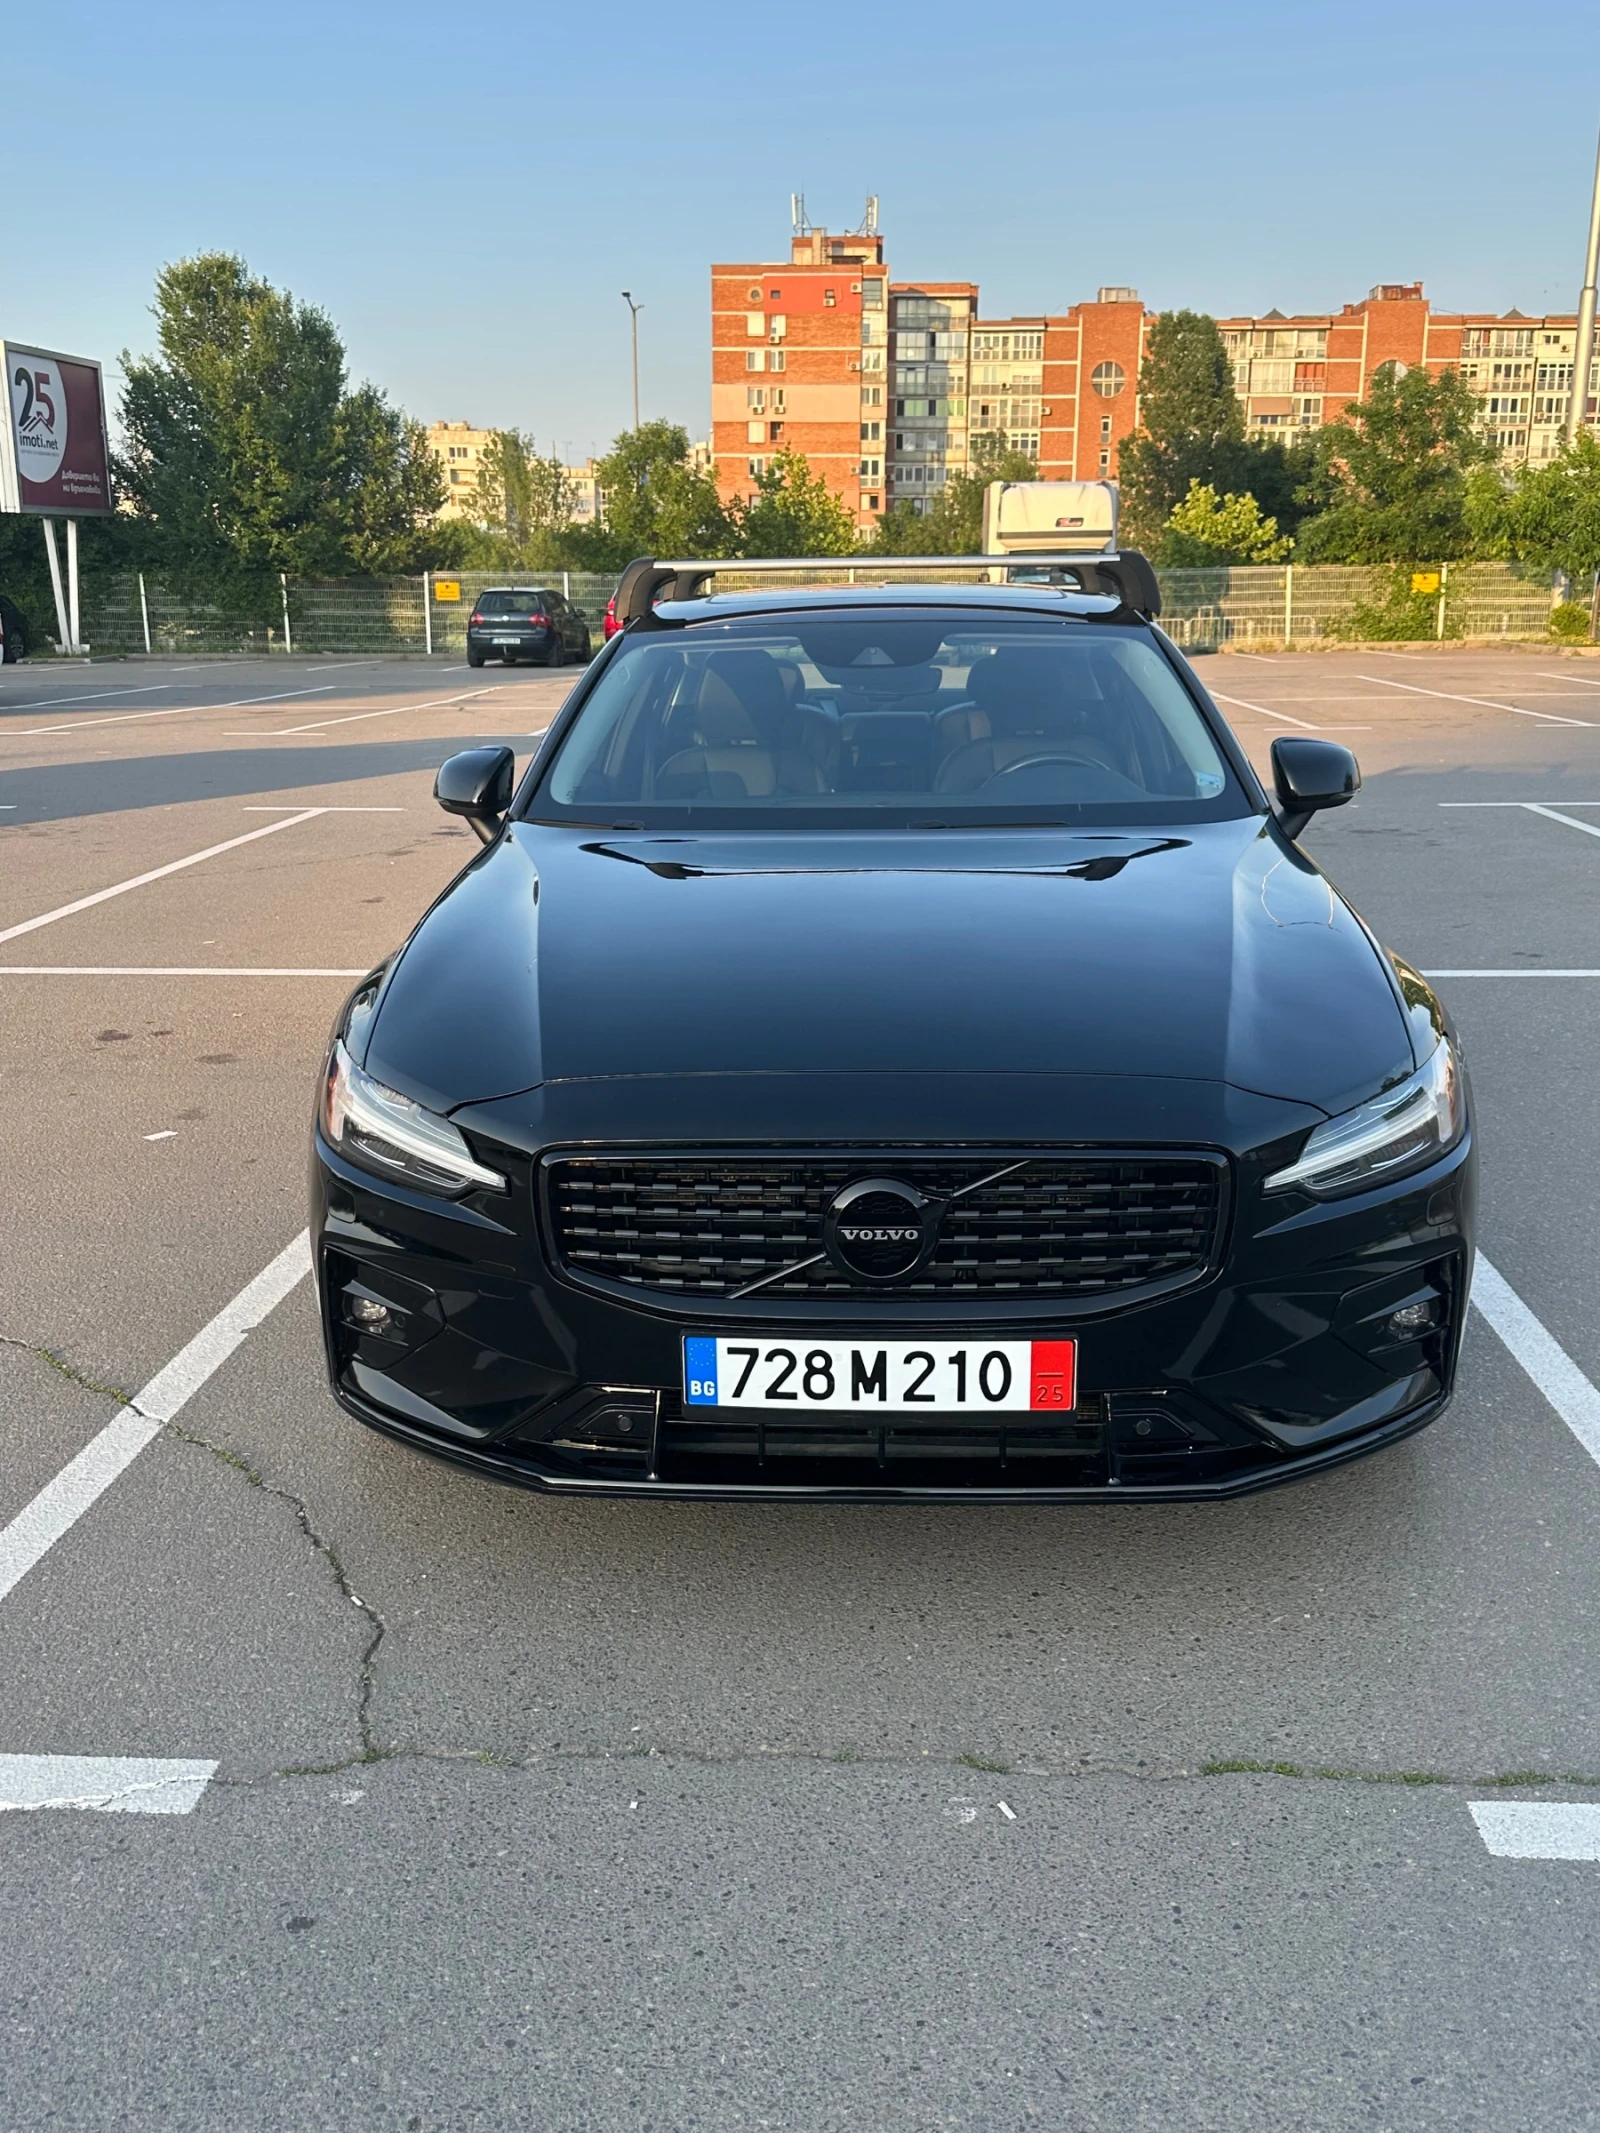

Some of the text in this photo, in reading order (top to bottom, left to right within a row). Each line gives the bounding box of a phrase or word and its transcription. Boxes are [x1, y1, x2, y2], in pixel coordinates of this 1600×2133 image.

[15, 367, 55, 428] 25
[19, 432, 59, 450] imoti.net
[840, 1229, 919, 1241] VOLVO
[690, 1380, 716, 1397] BG
[1036, 1384, 1064, 1403] 25
